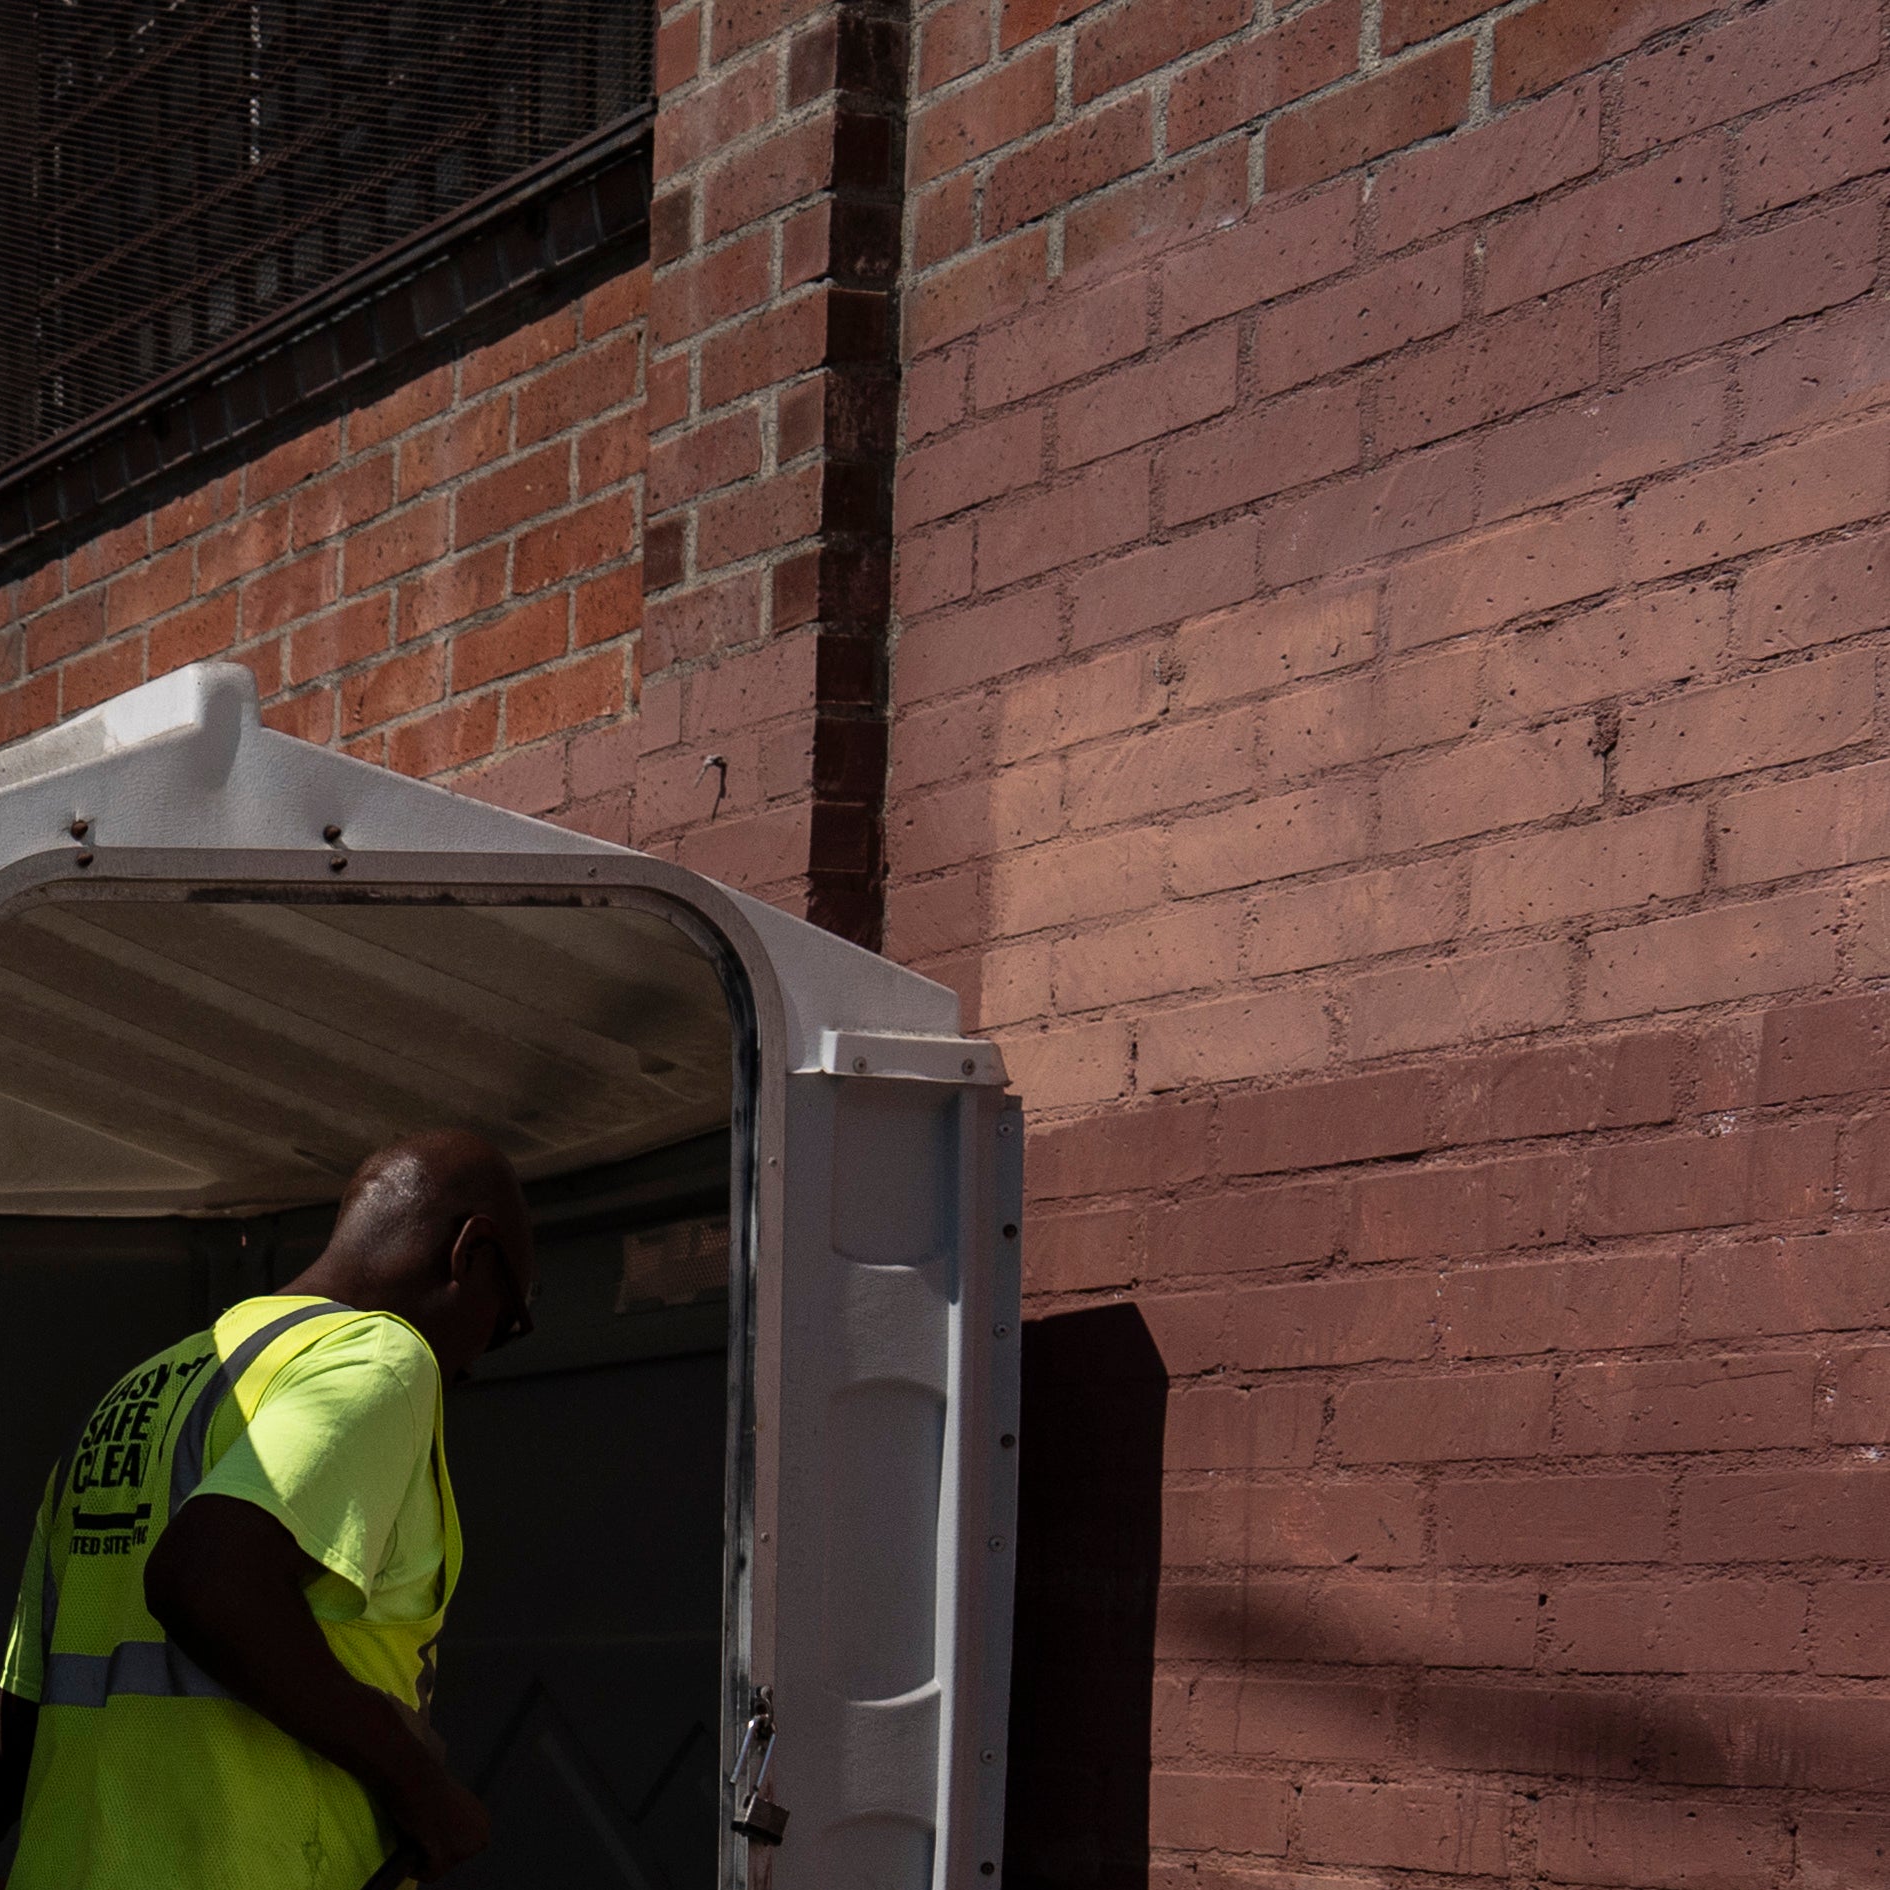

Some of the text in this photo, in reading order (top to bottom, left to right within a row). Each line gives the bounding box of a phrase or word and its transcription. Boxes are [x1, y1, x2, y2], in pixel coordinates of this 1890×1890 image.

[82, 1401, 159, 1449] SAFE
[72, 1443, 152, 1493] CLEA
[102, 1535, 132, 1555] SITE
